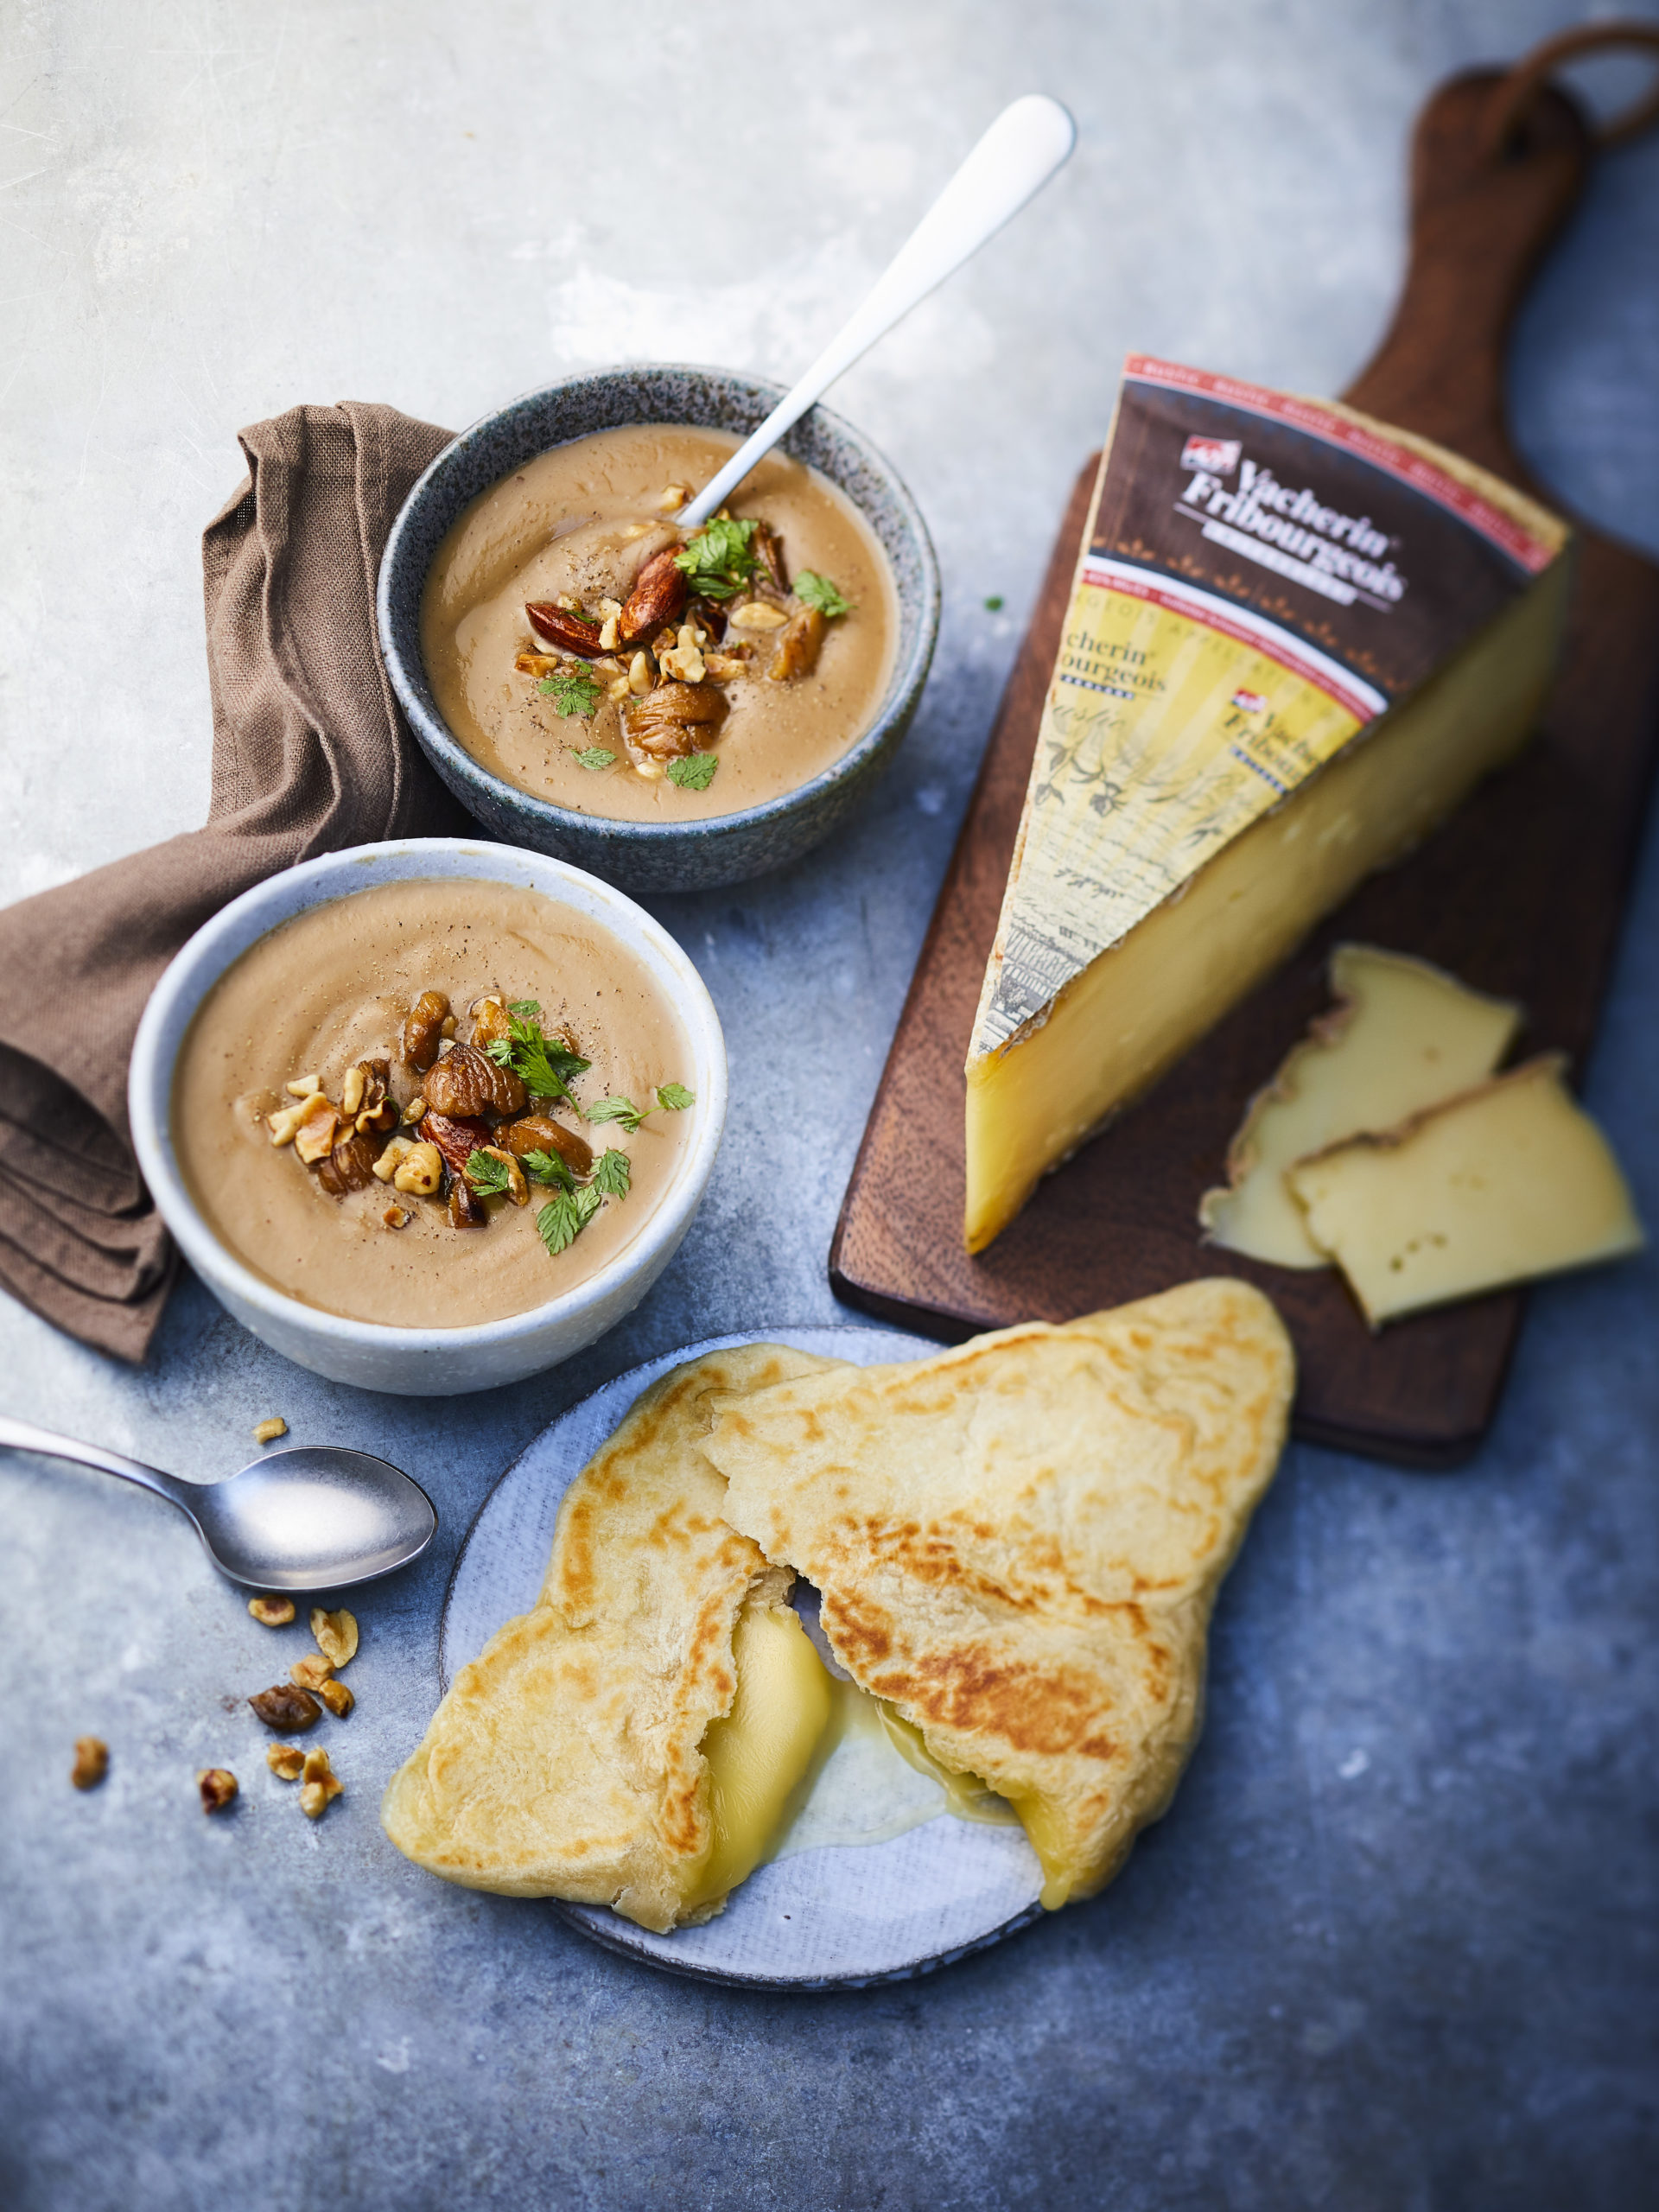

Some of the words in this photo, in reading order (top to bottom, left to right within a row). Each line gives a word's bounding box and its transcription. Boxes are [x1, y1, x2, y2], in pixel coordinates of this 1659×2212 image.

[1180, 471, 1405, 602] Fribourgeois
[1238, 458, 1389, 558] Vacherin
[1061, 652, 1166, 691] ourgeois
[1066, 631, 1147, 665] cherin
